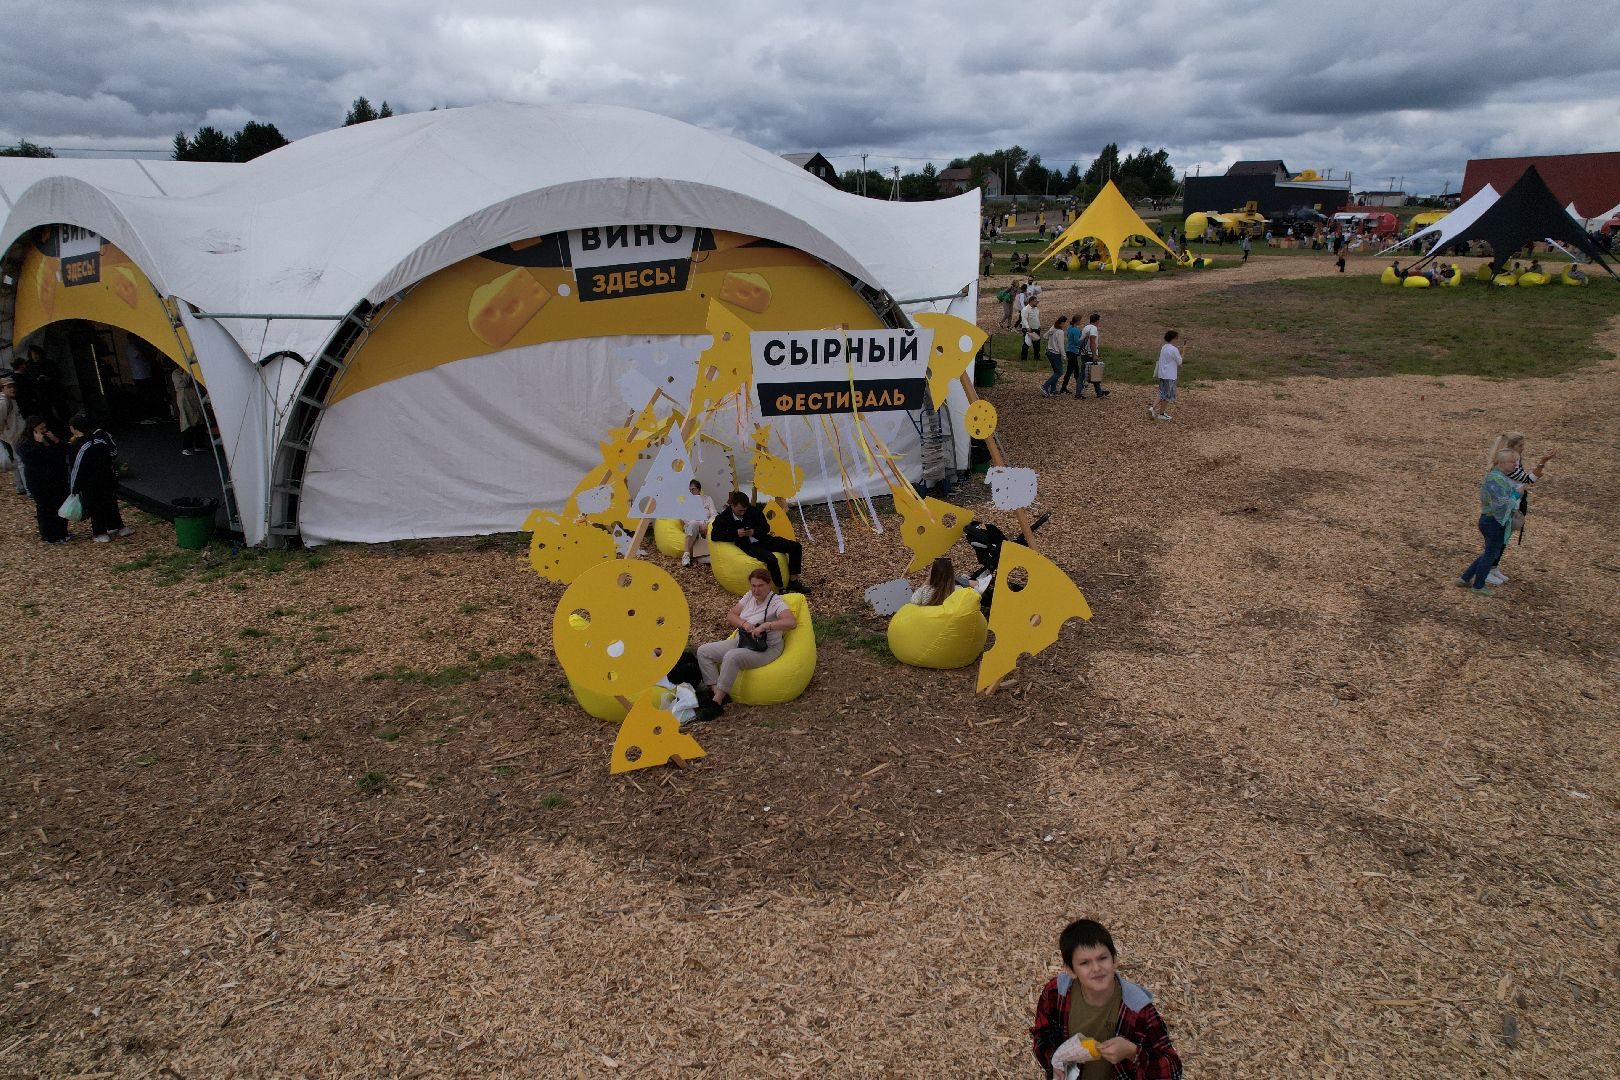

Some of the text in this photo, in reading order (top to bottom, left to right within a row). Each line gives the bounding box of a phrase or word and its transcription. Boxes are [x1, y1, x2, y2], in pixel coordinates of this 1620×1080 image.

[581, 224, 683, 251] ВИНО
[66, 258, 96, 281] ЗДЕСЬ!
[592, 266, 677, 294] ЗДЕСЬ!
[763, 329, 918, 366] СЫРНЫЙ
[775, 388, 905, 412] ФЕСТИВАЛЬ
